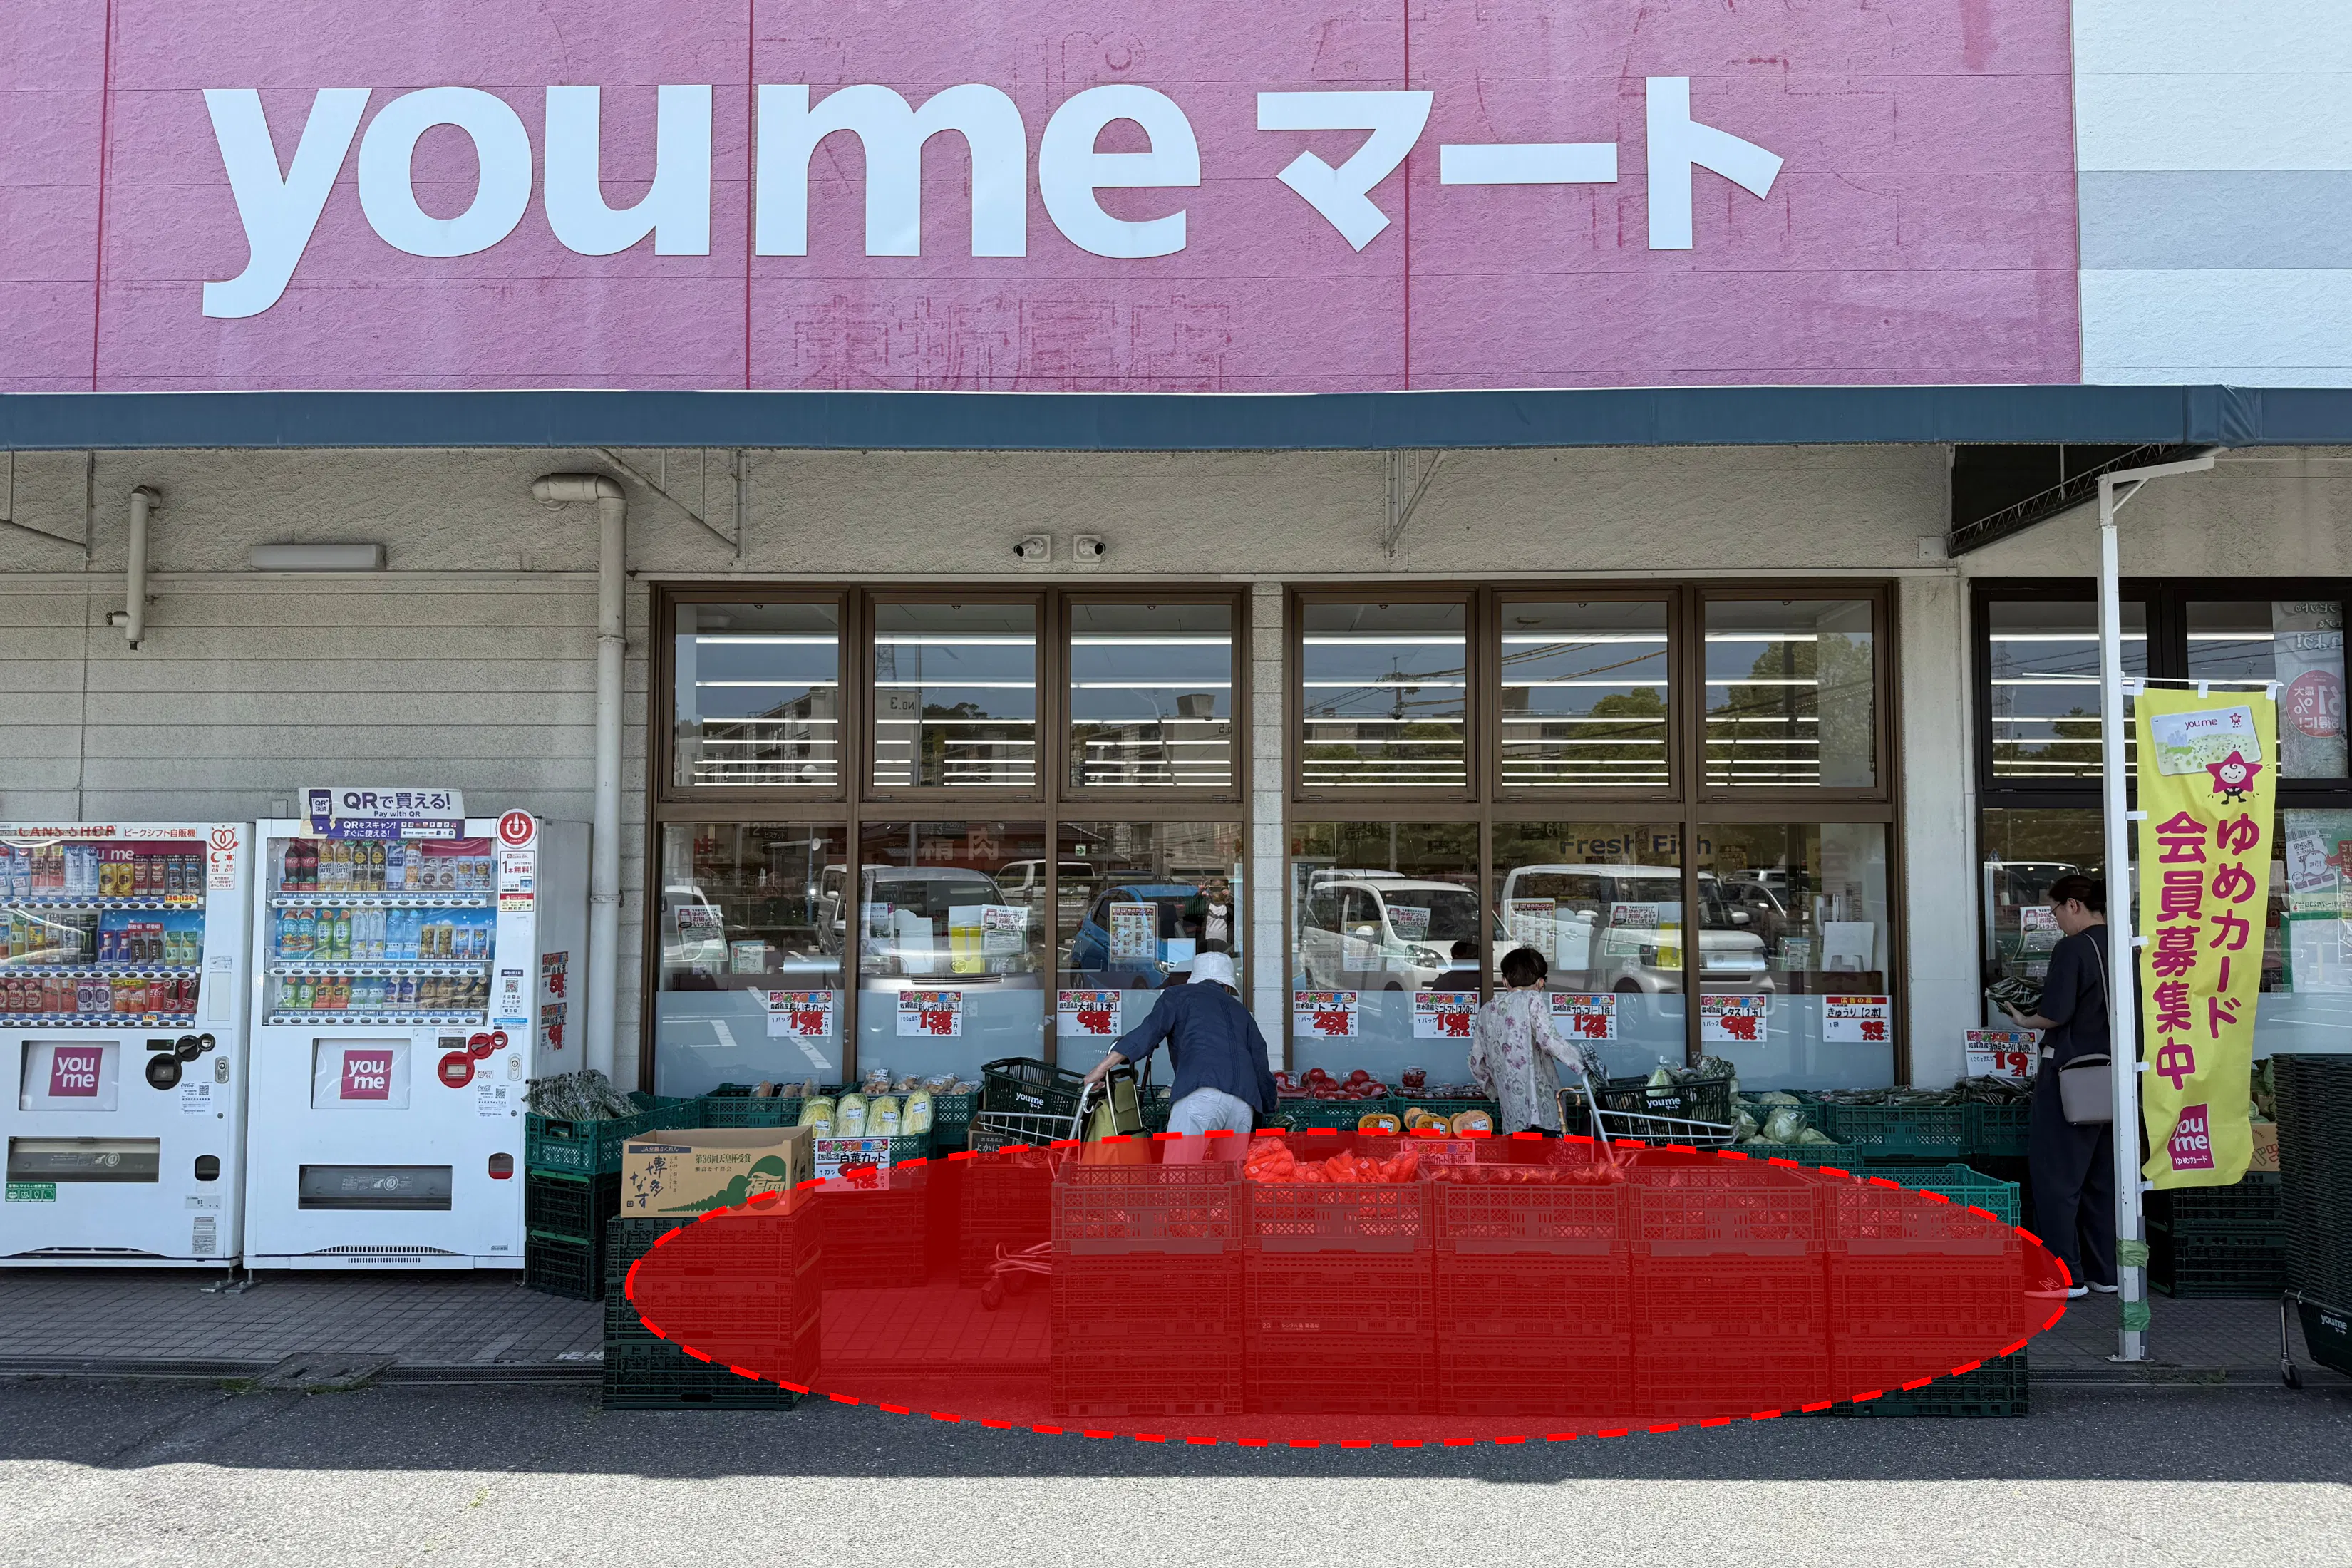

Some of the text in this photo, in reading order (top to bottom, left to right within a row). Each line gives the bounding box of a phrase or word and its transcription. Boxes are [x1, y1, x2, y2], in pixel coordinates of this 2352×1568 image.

[1257, 76, 1785, 253] マート
[343, 792, 451, 810] QRで買える!
[343, 820, 396, 830] QRをスキャン!
[1653, 834, 1711, 855] Fih
[2208, 813, 2261, 1040] ゆめカード
[2152, 810, 2208, 1090] 会員募集中
[789, 1003, 830, 1012] 長いもカット
[1317, 1004, 1350, 1013] トマト
[790, 1011, 824, 1029] 198
[919, 1011, 954, 1029] 138
[1077, 1011, 1112, 1028] 98
[1436, 1013, 1470, 1031] 198
[1572, 1014, 1608, 1032] 128
[1719, 1016, 1757, 1034] 98
[58, 1056, 95, 1076] you
[348, 1059, 385, 1078] you
[1993, 1052, 2028, 1070] 19
[62, 1073, 95, 1088] me
[354, 1076, 385, 1090] me
[974, 1142, 1007, 1152] よかに
[2175, 1135, 2208, 1152] me
[840, 1152, 886, 1163] 白菜カット
[982, 1153, 1001, 1162] 大根
[2175, 1155, 2209, 1165] ゆめカード
[646, 1155, 668, 1197] 博多
[629, 1171, 649, 1209] なす
